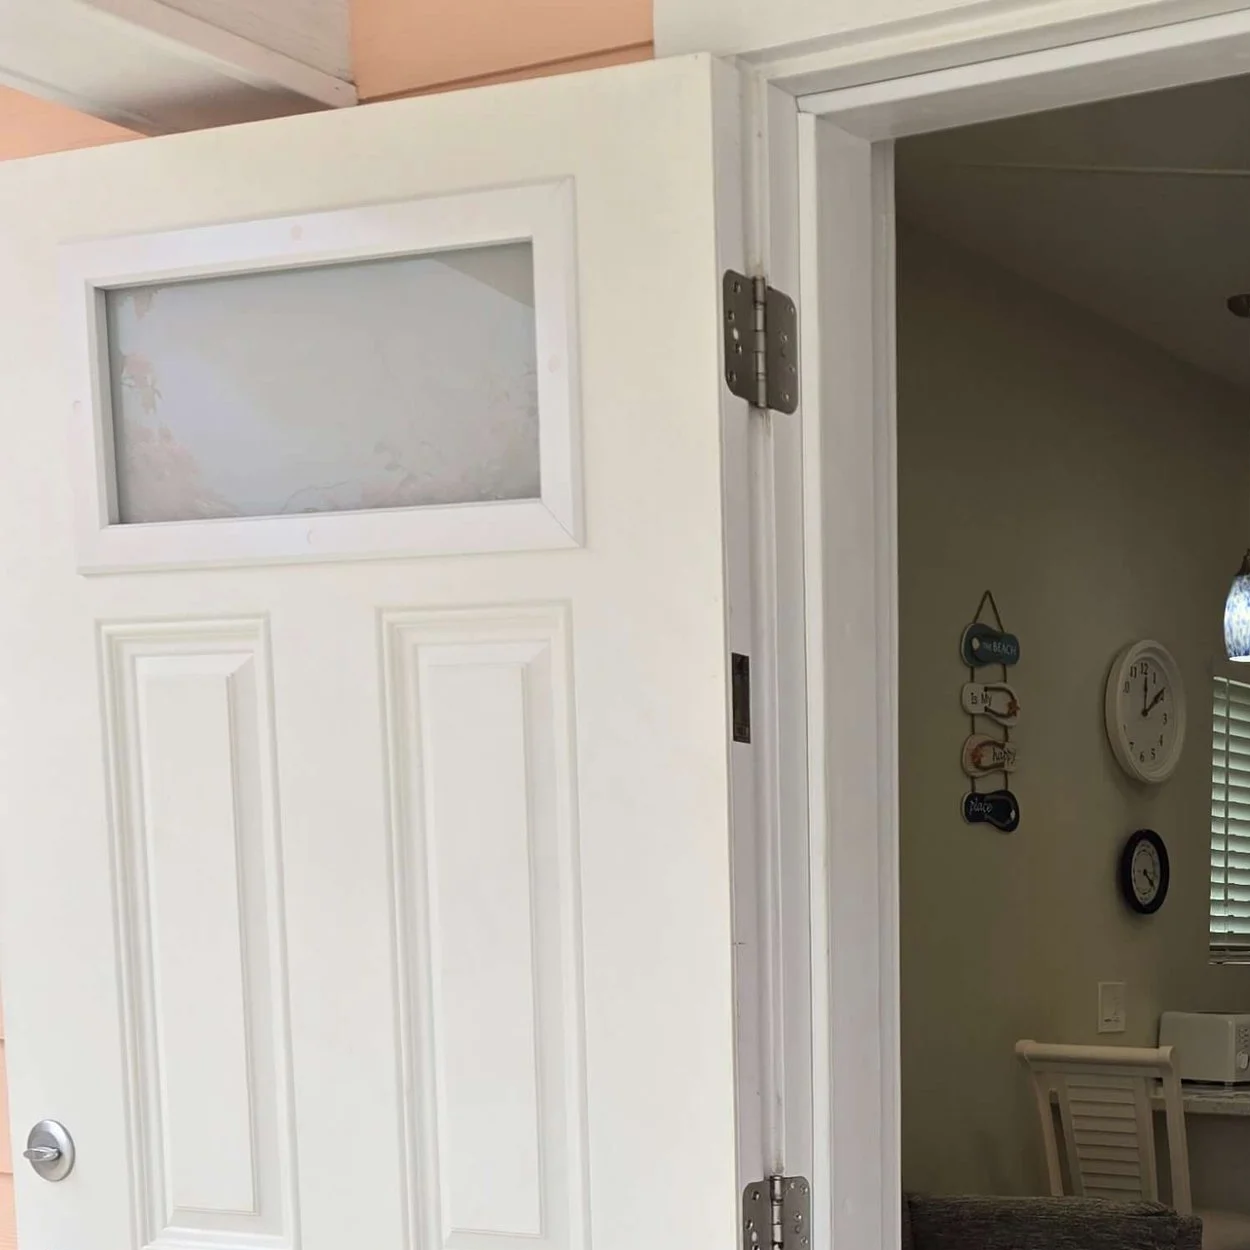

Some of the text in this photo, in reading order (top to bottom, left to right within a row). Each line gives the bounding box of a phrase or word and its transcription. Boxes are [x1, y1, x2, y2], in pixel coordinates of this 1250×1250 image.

[992, 642, 1017, 655] BEACH
[1130, 666, 1137, 678] 11
[1140, 662, 1149, 675] 12
[1152, 671, 1157, 684] 1
[1162, 712, 1168, 726] 3
[992, 746, 1017, 765] happy
[1139, 750, 1145, 763] 6
[1150, 747, 1156, 761] 5
[968, 796, 993, 816] place
